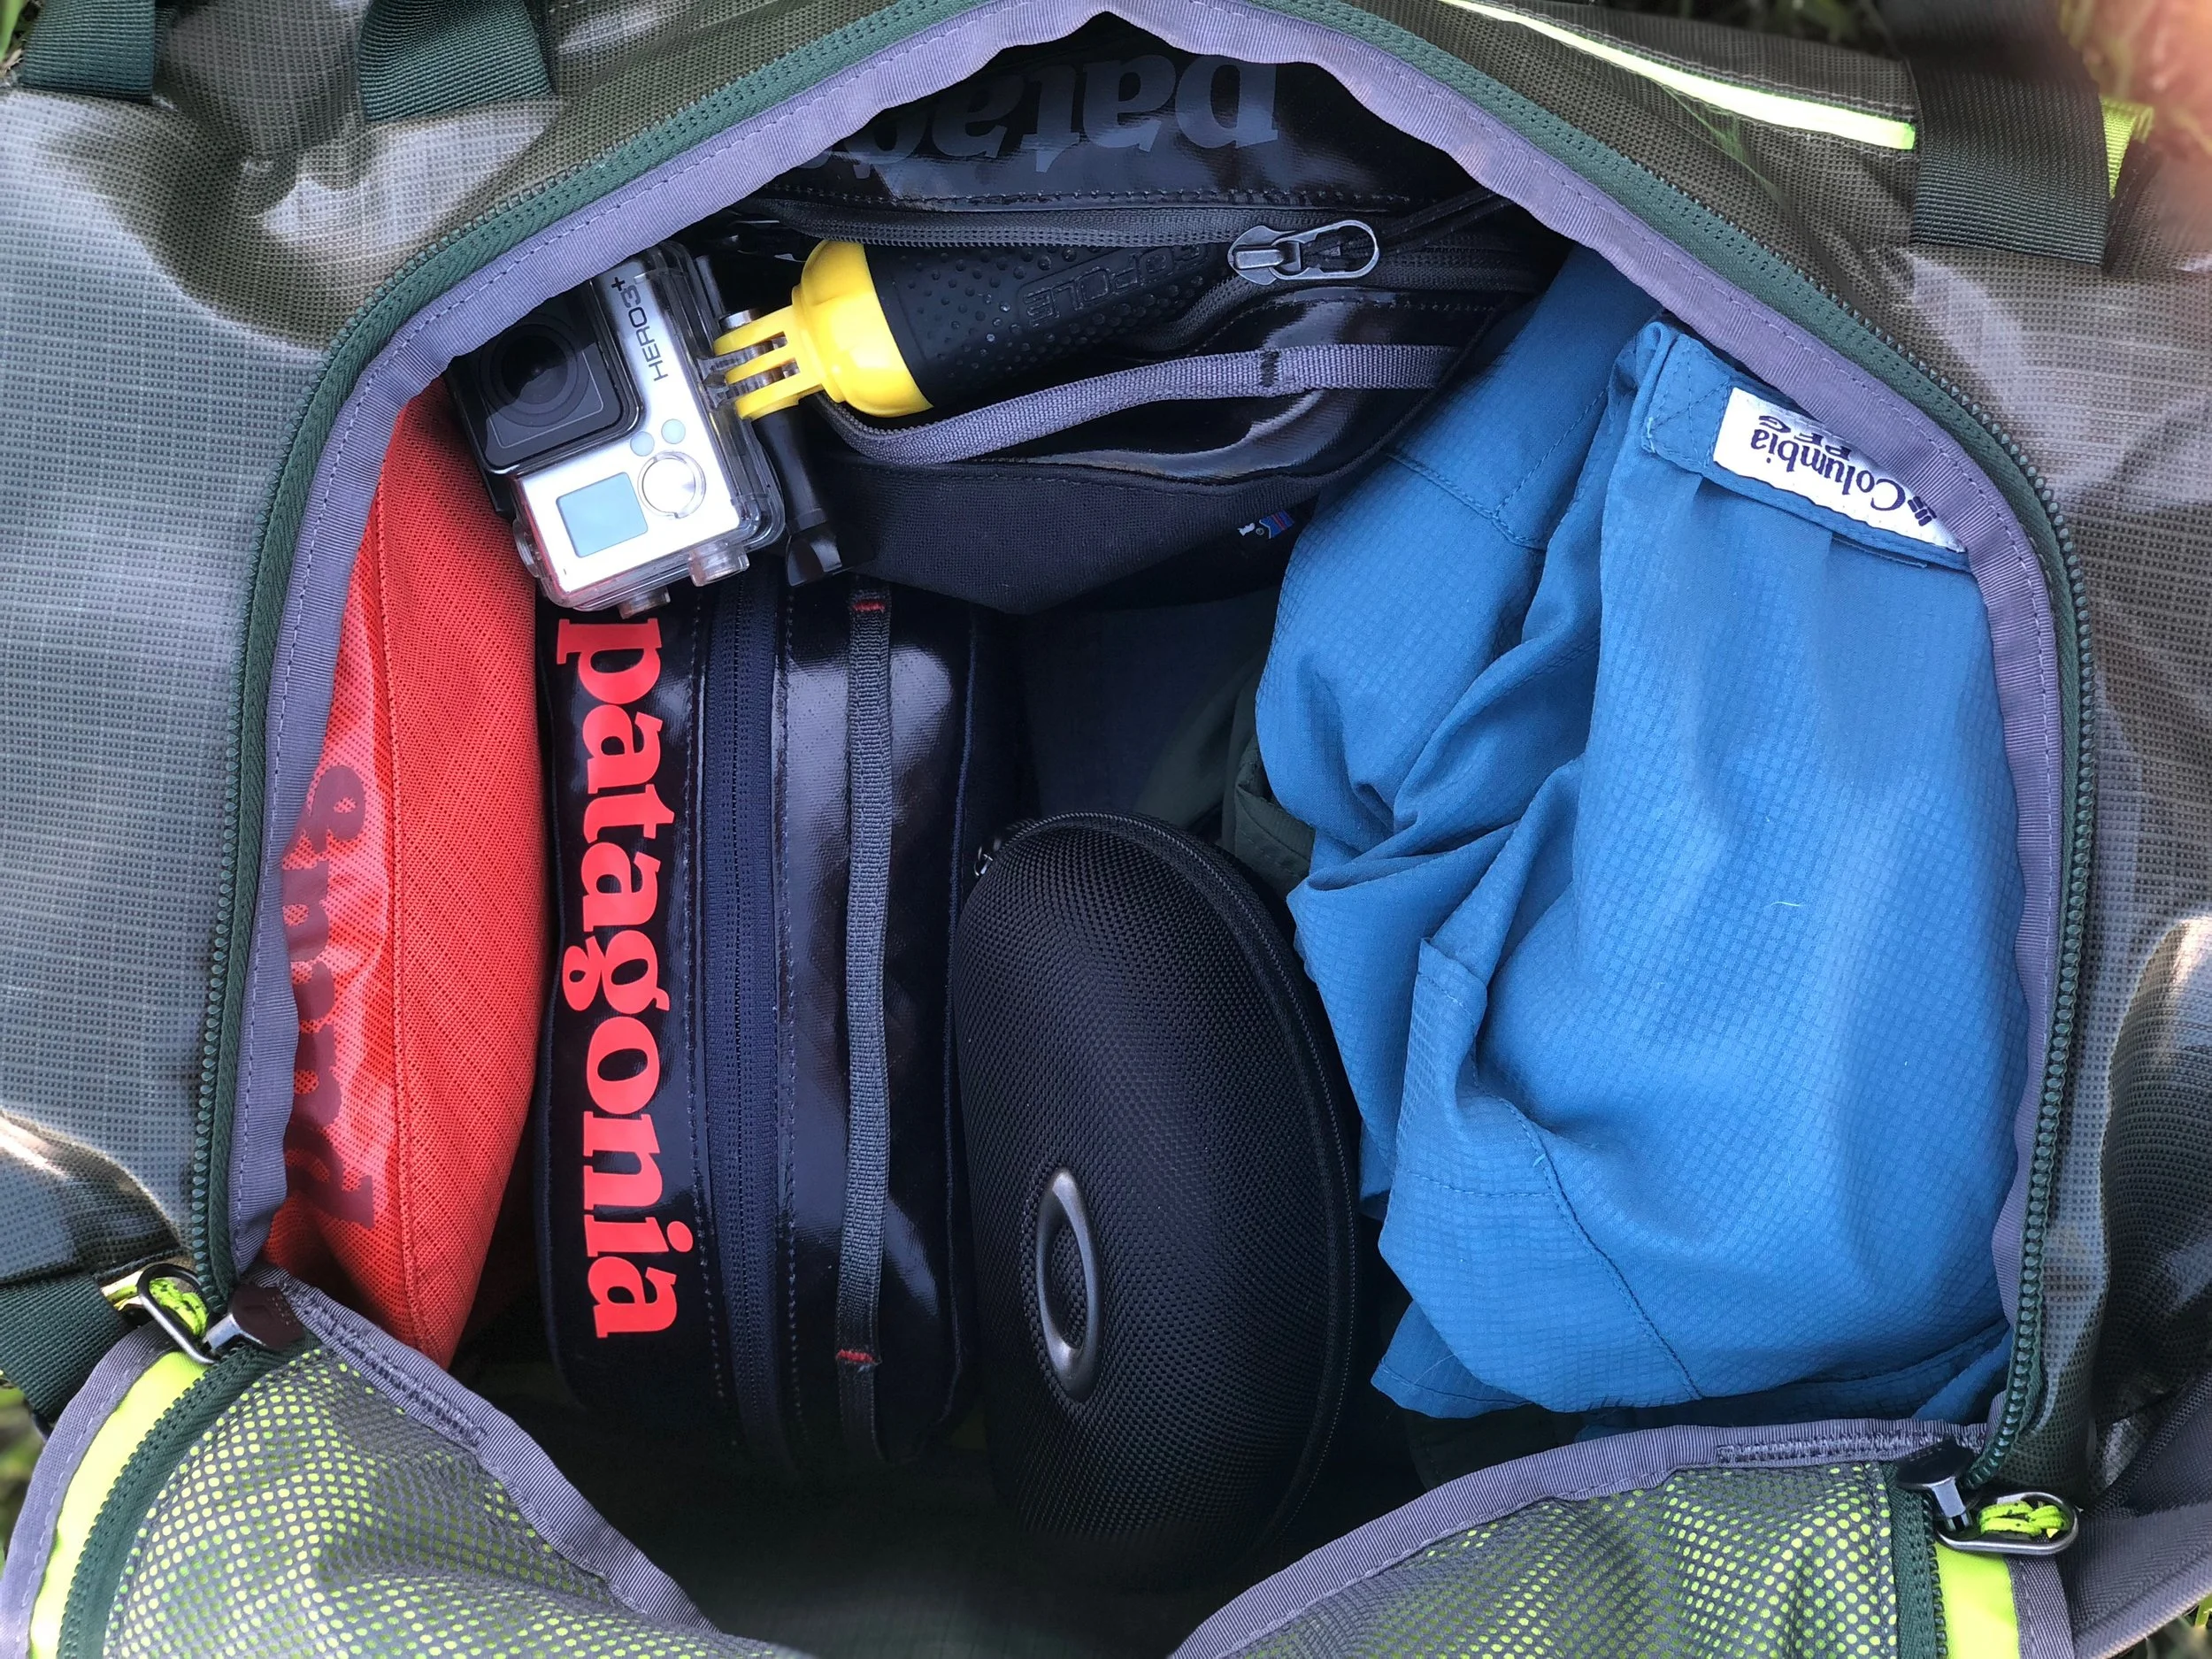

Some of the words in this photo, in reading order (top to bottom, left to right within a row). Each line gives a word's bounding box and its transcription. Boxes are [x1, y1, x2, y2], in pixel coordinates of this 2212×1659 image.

[611, 276, 669, 381] HERO3+
[1750, 428, 1907, 511] Columbia
[556, 618, 694, 1339] patagonia
